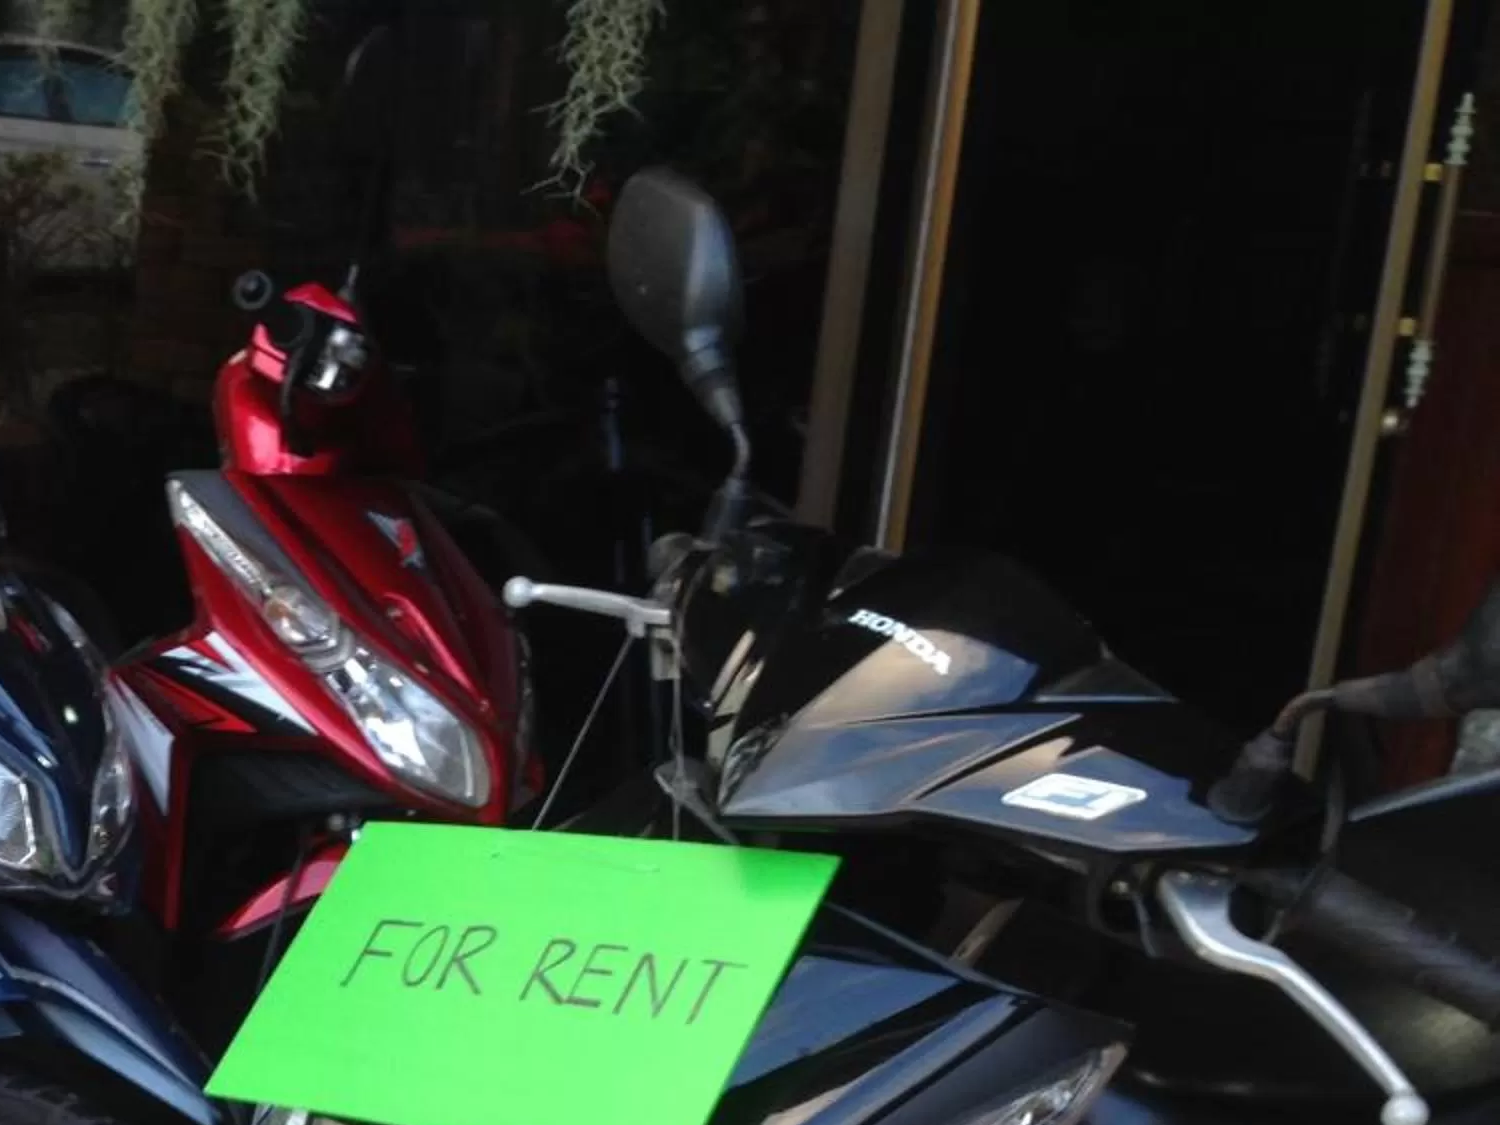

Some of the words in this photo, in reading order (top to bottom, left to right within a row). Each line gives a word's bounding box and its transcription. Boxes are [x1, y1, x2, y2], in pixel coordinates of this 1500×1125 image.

[848, 608, 952, 676] HONDA
[340, 919, 497, 996] FOR
[518, 937, 749, 1025] RENT
